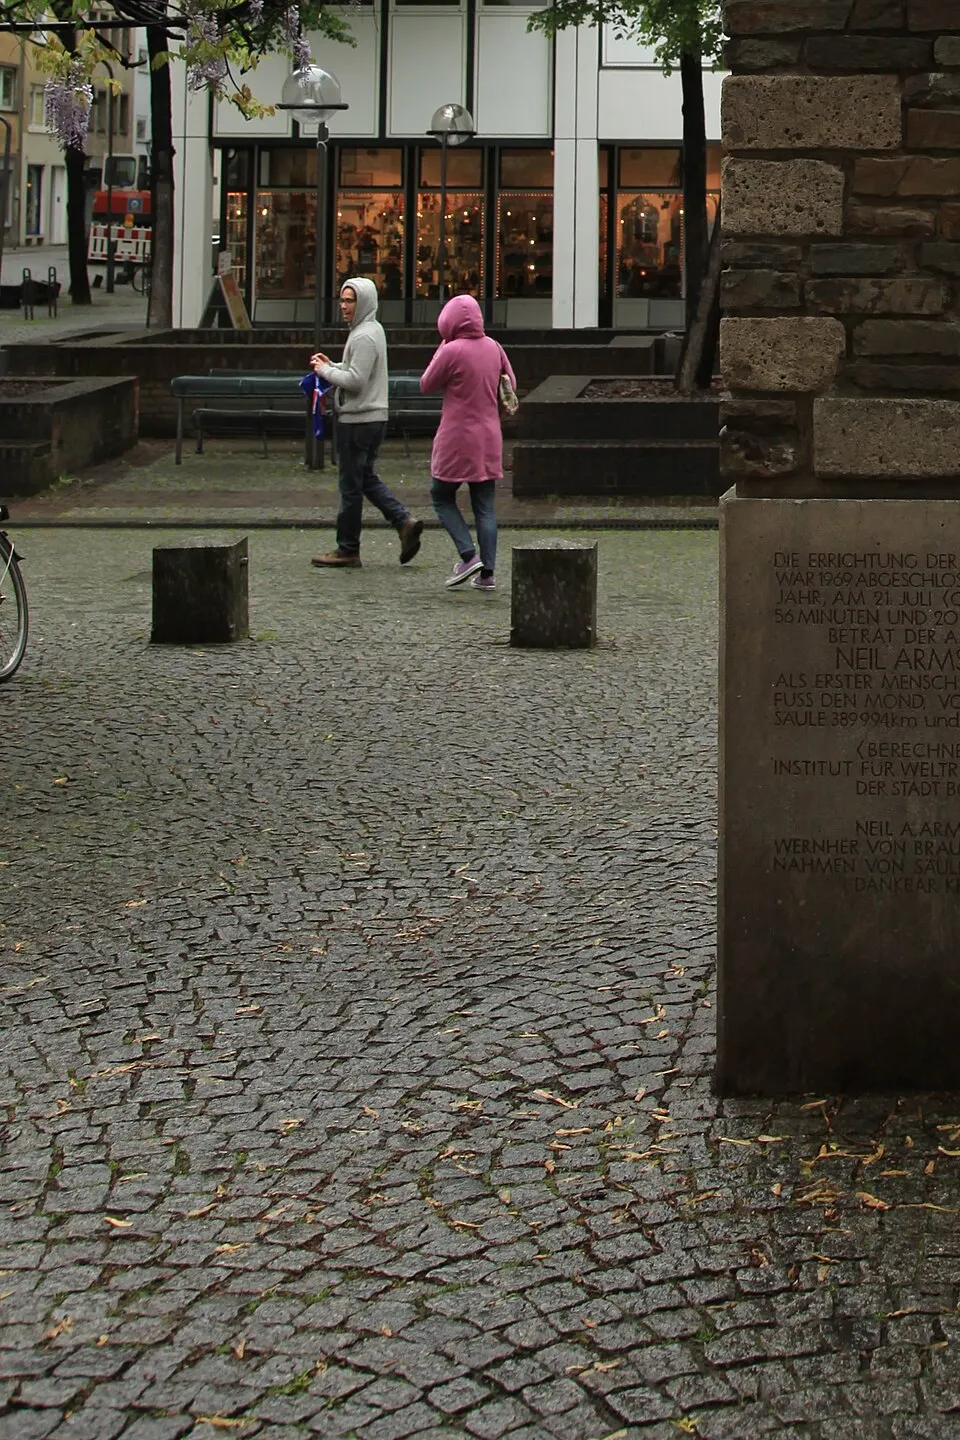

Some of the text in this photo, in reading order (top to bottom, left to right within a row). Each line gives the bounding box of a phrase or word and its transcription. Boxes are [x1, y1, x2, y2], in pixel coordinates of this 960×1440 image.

[774, 553, 799, 568] DIE
[808, 553, 918, 569] ERRICHTUNG
[926, 554, 957, 568] DER
[776, 572, 814, 586] WAR
[819, 572, 853, 587] 1969
[776, 590, 826, 607] JAHR,
[832, 591, 865, 605] AM
[874, 591, 892, 605] 21.
[899, 591, 931, 606] JULI
[775, 609, 794, 623] 56
[797, 610, 879, 625] MINUTEN
[888, 611, 927, 625] UND
[935, 611, 958, 625] 20
[829, 628, 894, 644] BETRAT
[905, 629, 937, 644] DER
[836, 647, 886, 670] NEIL
[776, 673, 807, 688] ALS
[815, 674, 873, 689] ERSTER
[881, 674, 957, 690] MENSCH
[773, 692, 813, 707] FUSS
[821, 693, 857, 708] DEN
[864, 694, 926, 710] MOND,
[924, 712, 959, 728] und
[773, 760, 852, 776] INSTITUT
[861, 761, 895, 777] FÜR
[856, 780, 888, 796] DER
[891, 781, 940, 797] STADT
[856, 820, 893, 836] NEIL
[774, 839, 859, 855] WERNHER
[867, 840, 905, 855] VON
[773, 857, 855, 873] NAHMEN
[865, 859, 904, 874] VON
[855, 877, 938, 893] DANKBAR
